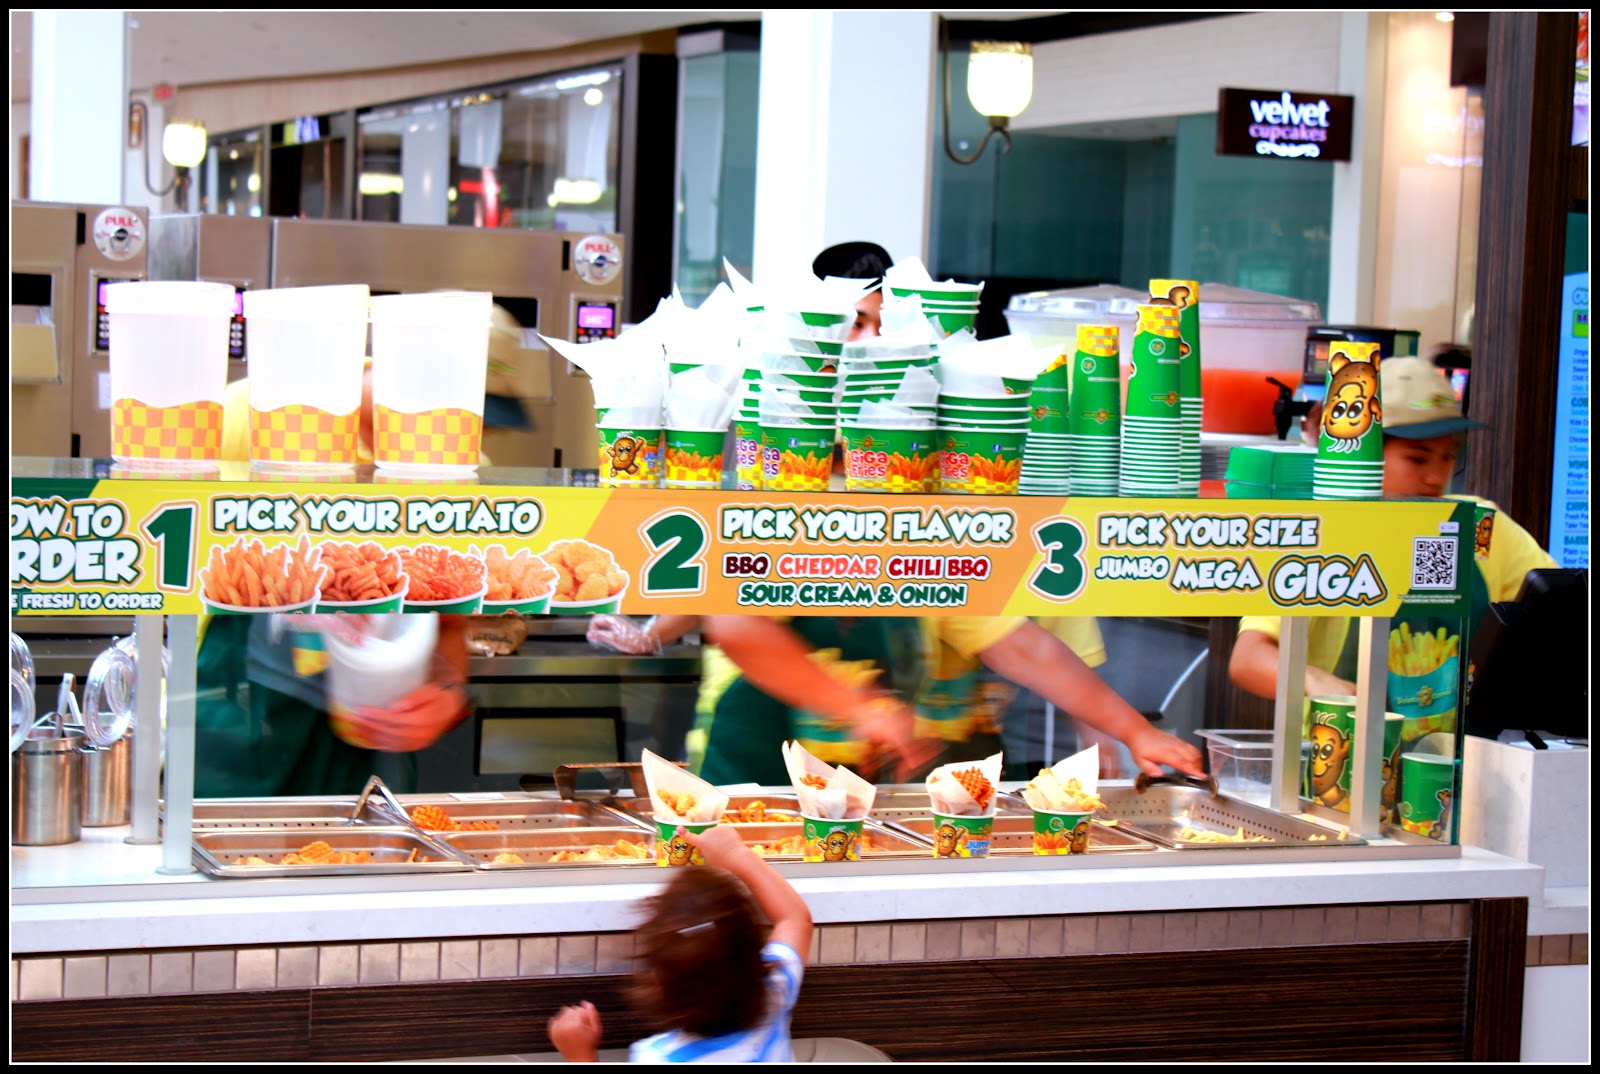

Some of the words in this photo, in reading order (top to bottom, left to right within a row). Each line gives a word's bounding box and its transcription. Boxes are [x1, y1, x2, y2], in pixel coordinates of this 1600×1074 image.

[1250, 91, 1330, 127] velvet
[1249, 123, 1327, 142] cupcakes
[105, 216, 134, 227] PULL
[585, 243, 610, 253] PULL
[12, 502, 67, 538] OW
[72, 503, 125, 539] TO
[214, 498, 298, 532] PICK
[303, 500, 399, 533] YOUR
[407, 500, 541, 533] POTATO
[722, 508, 797, 541] PICK
[801, 510, 886, 542] YOUR
[892, 509, 1013, 543] FLAVOR
[1099, 516, 1167, 546] PICK
[1171, 517, 1249, 547] YOUR
[1252, 518, 1318, 547] SIZE
[12, 538, 139, 583] RDER
[145, 506, 193, 588] 1
[645, 514, 704, 590] 2
[1036, 521, 1084, 597] 3
[725, 556, 768, 575] BBQ
[779, 557, 879, 576] CHEDDAR
[888, 558, 944, 577] CHILI
[948, 559, 989, 577] BBQ
[1096, 556, 1170, 580] JUMBO
[1172, 558, 1262, 590] MEGA
[1273, 560, 1383, 601] GIGA
[21, 593, 76, 609] FRESH
[78, 594, 101, 609] TO
[104, 593, 163, 609] ORDER
[740, 584, 796, 603] SOUR
[799, 585, 874, 604] CREAM
[879, 587, 895, 602] &
[898, 585, 966, 604] ONION
